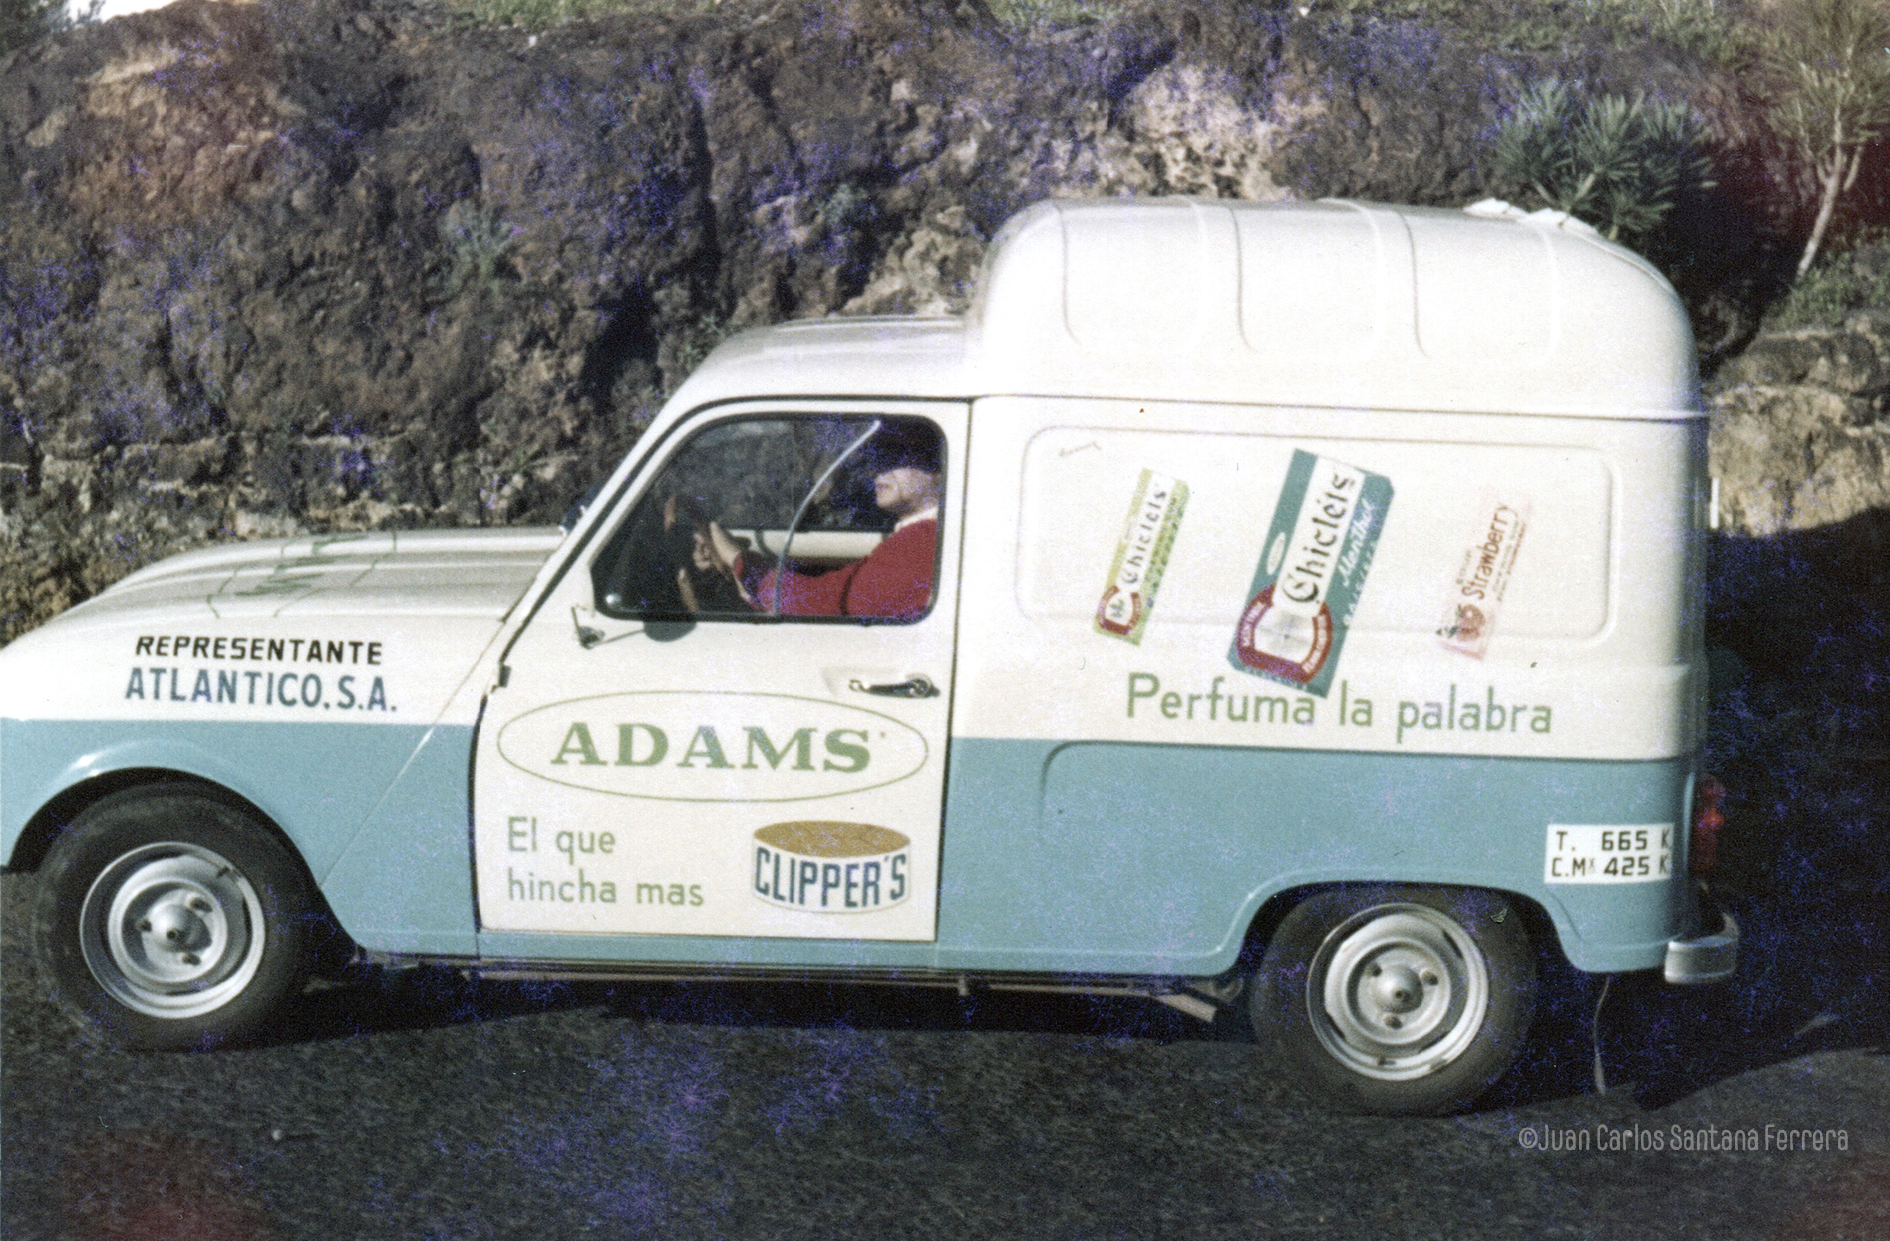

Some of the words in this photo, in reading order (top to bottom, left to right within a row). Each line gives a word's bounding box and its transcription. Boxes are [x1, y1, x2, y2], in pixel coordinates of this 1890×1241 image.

[1282, 471, 1355, 604] Chiclets
[1337, 499, 1375, 588] Menthol
[1461, 503, 1518, 600] Strawberry
[135, 635, 383, 666] REPRESENTANTE
[1127, 672, 1316, 725] Perfuma
[1340, 680, 1374, 727] la
[1398, 684, 1553, 744] palabra
[550, 722, 872, 773] ADAMS
[508, 816, 537, 852] El
[555, 830, 616, 866] que
[1556, 830, 1576, 851] T.
[1602, 830, 1648, 851] 665
[1604, 855, 1650, 876] 425
[508, 866, 618, 903] hincha
[636, 882, 705, 907] mas
[755, 846, 907, 908] CLIPPER'S
